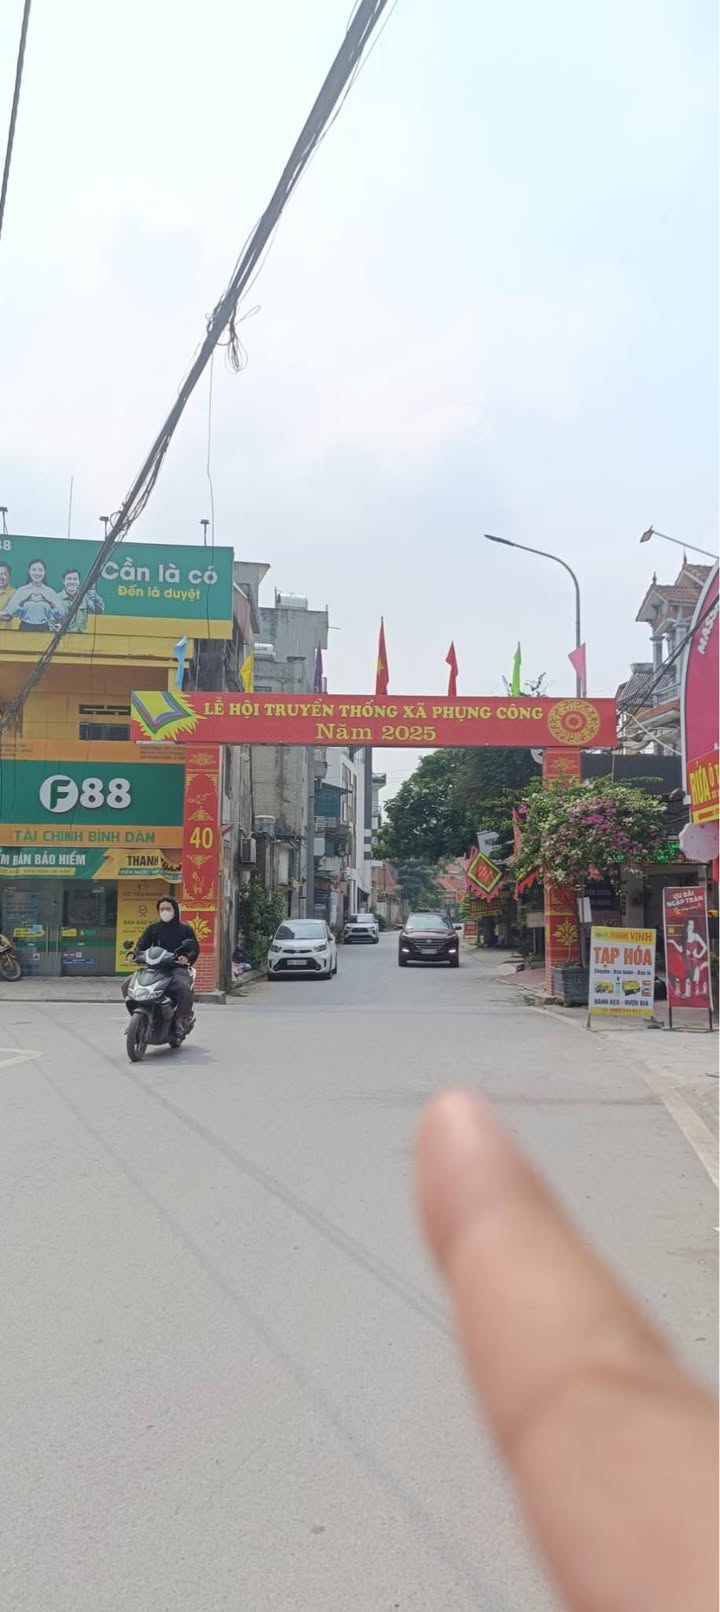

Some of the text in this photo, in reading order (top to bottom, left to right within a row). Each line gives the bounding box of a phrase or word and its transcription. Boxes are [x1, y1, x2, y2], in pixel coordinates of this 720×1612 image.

[0, 539, 12, 551] 8
[101, 557, 218, 584] Cần là có
[118, 584, 200, 602] Đến là duyệt
[203, 697, 543, 723] LỄ HỘI TRUYỀN THỐNG XÃ PHỤNG CÔNG
[316, 722, 437, 741] Năm 2025
[39, 775, 131, 813] F88
[190, 827, 213, 849] 40
[35, 851, 55, 865] BẢO
[127, 855, 159, 866] THANH
[593, 944, 652, 967] TẠP HÓA
